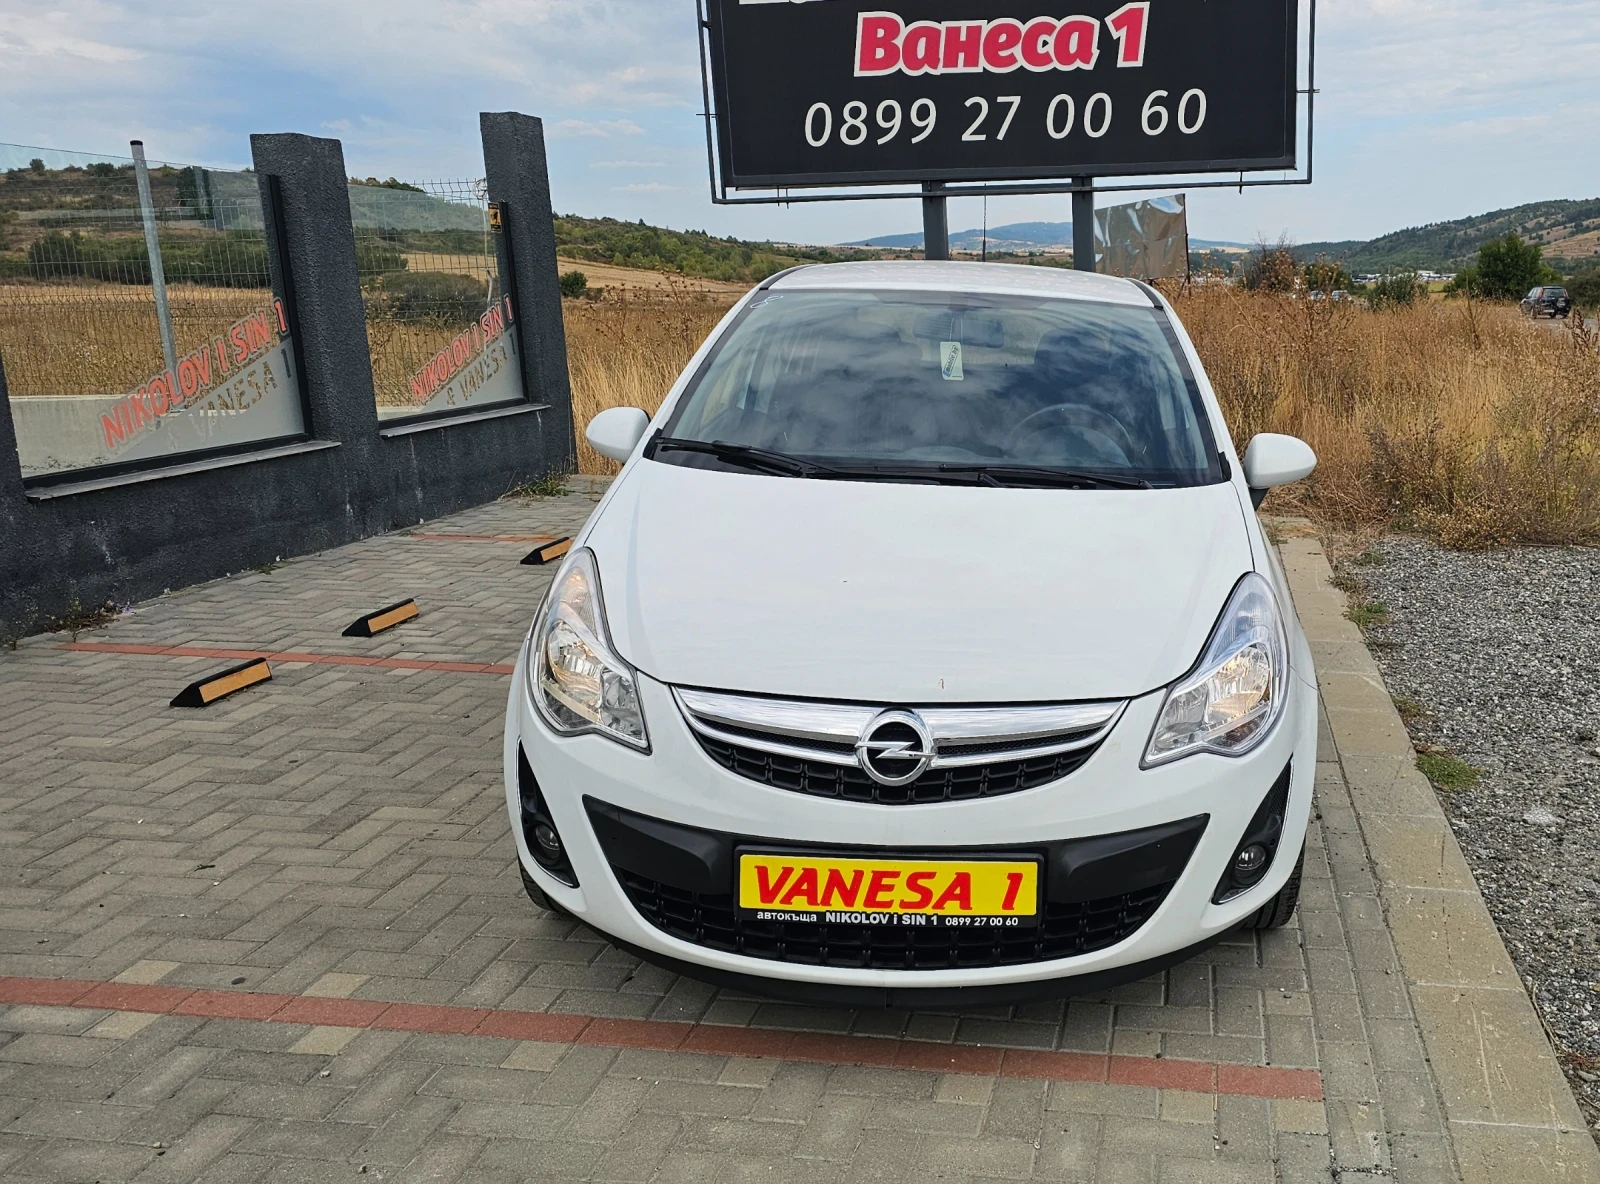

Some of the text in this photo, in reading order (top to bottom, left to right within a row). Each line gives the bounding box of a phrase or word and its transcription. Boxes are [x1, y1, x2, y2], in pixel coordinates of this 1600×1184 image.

[854, 1, 1150, 77] Ванеса 1
[804, 88, 1207, 147] 0899 27 00 60
[100, 299, 288, 449] NIKOLOV I SIN 1
[281, 348, 292, 378] 1
[411, 294, 513, 402] NIKOLOV I SIN 1
[460, 344, 507, 400] VANESA
[509, 333, 516, 355] 1
[754, 865, 1024, 911] VANESA 1
[757, 911, 1019, 926] автокъща NIKOLOV i SIN 1 0899 27 00 60
